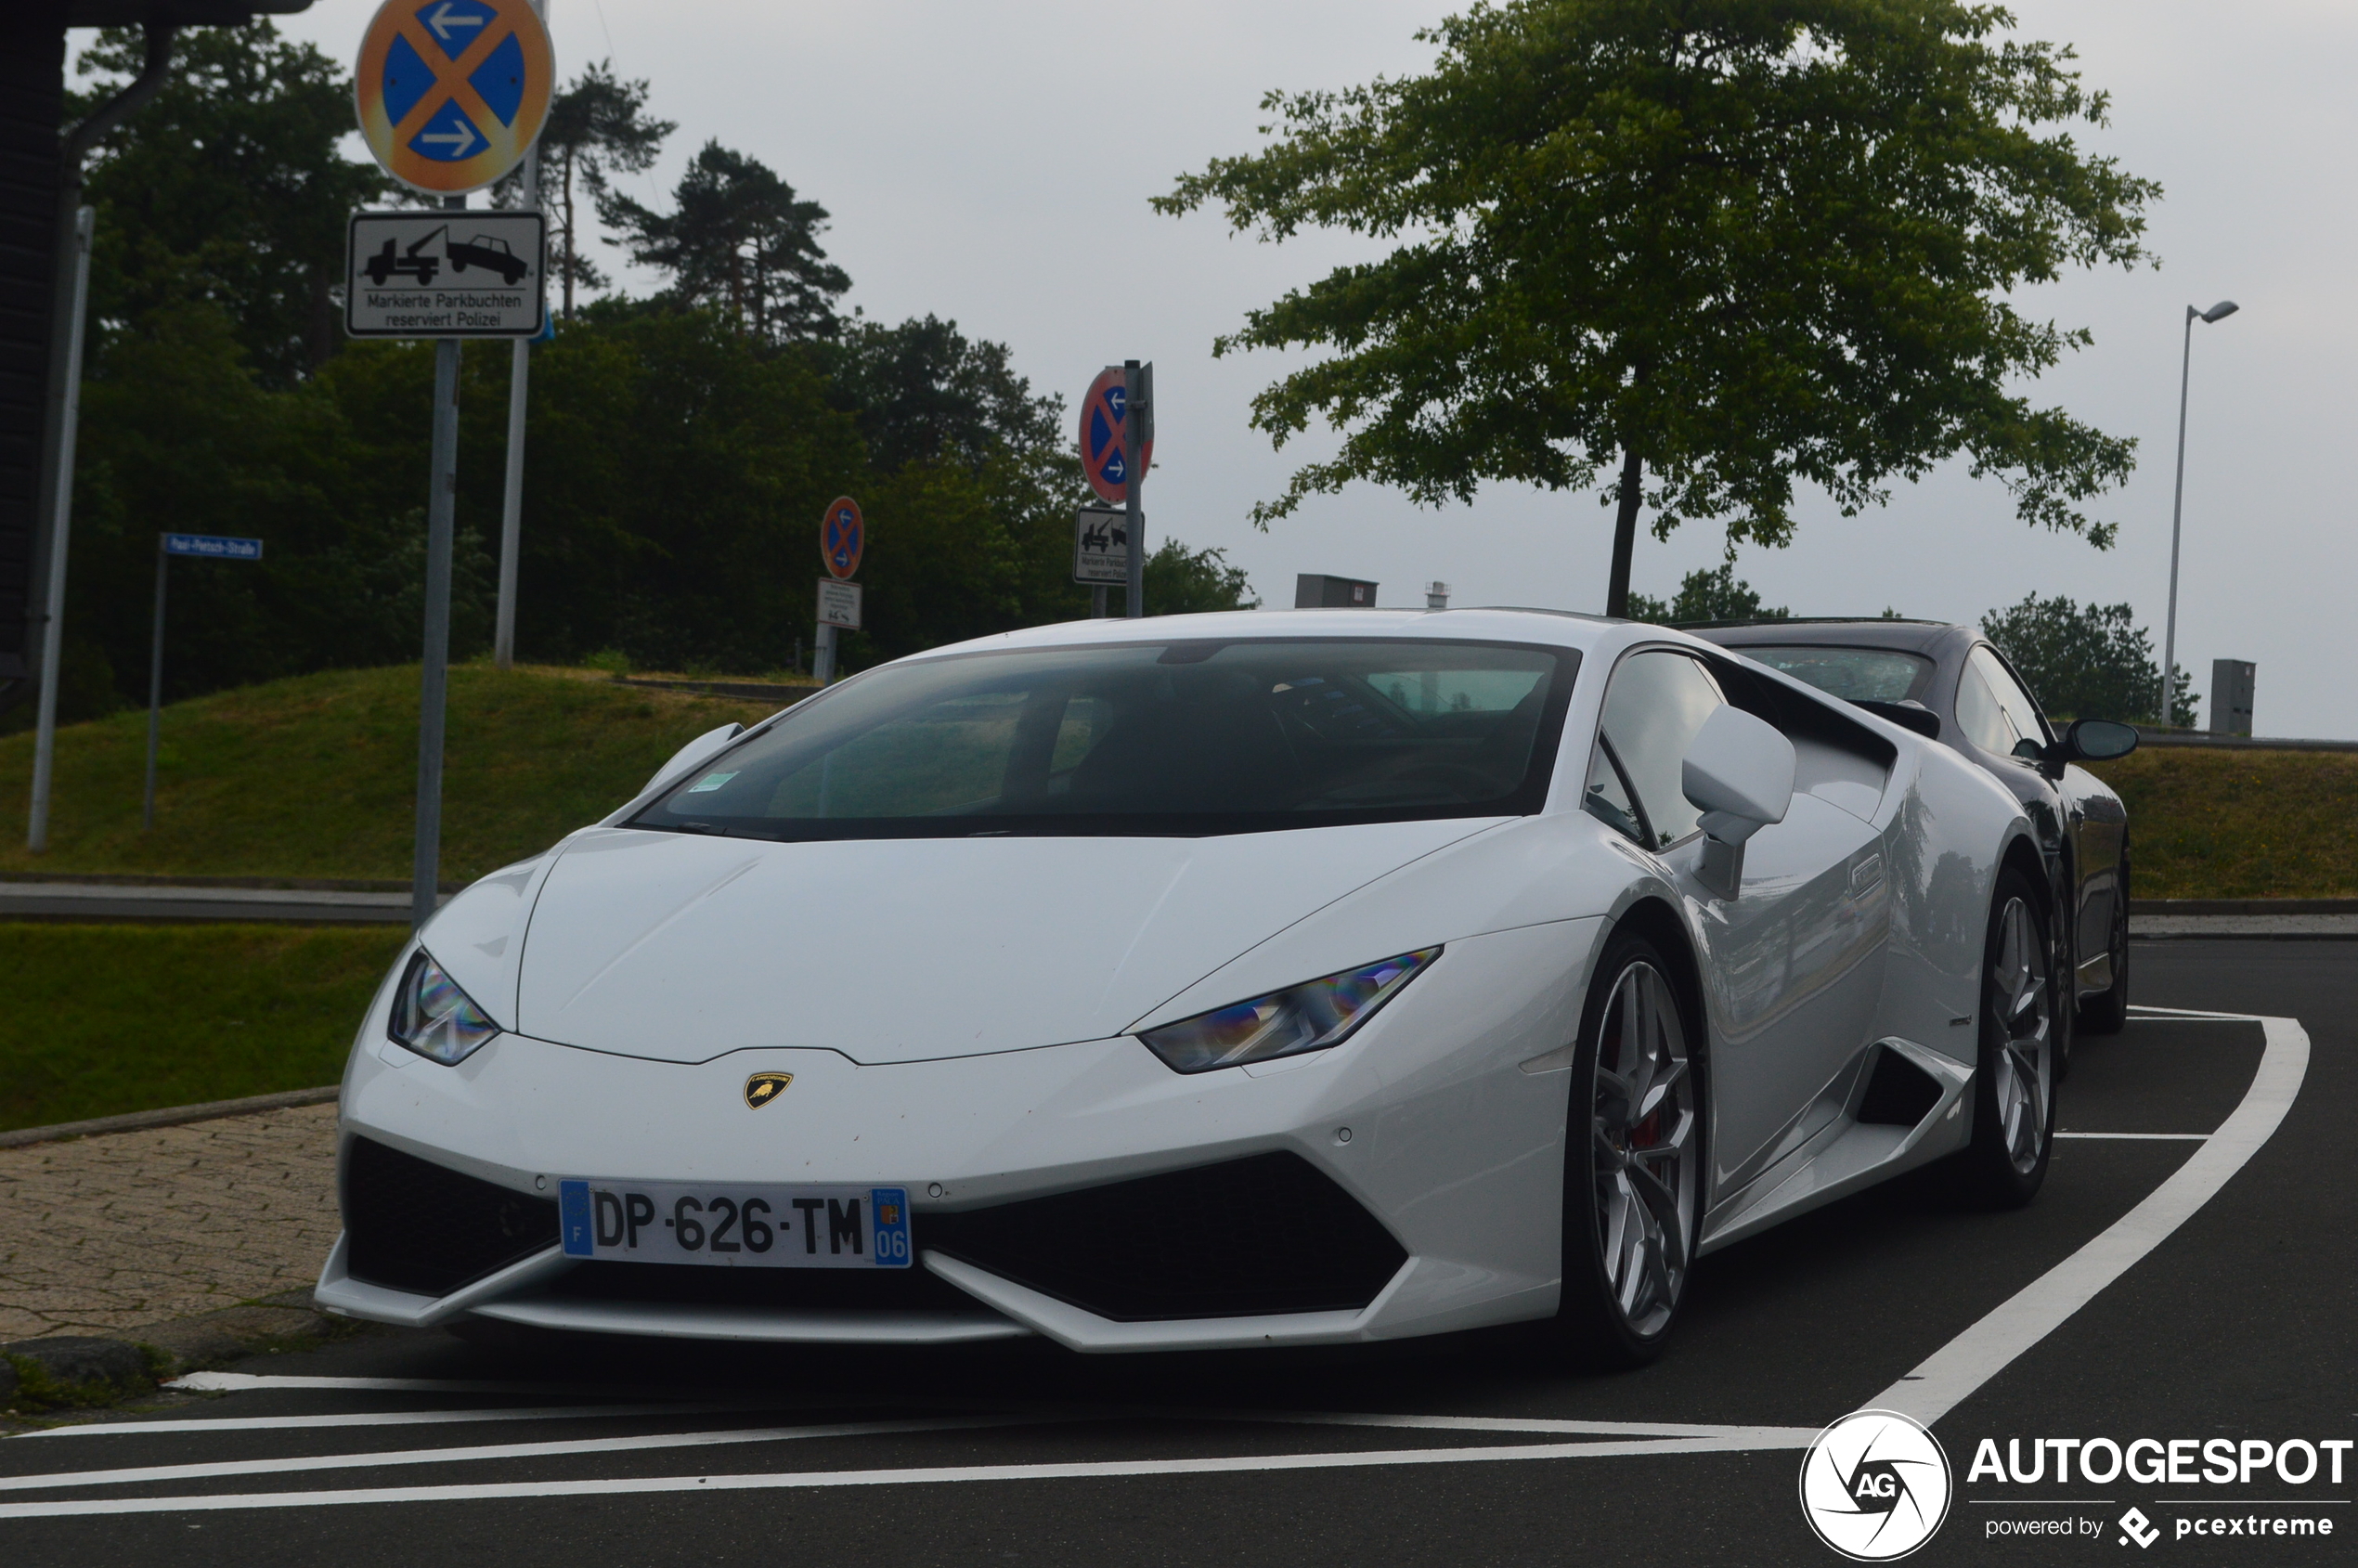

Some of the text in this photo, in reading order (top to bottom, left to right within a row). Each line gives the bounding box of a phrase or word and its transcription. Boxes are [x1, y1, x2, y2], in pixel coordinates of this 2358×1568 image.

[368, 292, 522, 308] Markierte Parkbuchten
[385, 311, 501, 326] reserviert Polizei
[593, 1192, 863, 1255] DP-626-TM
[572, 1225, 582, 1243] F
[876, 1230, 906, 1258] 06
